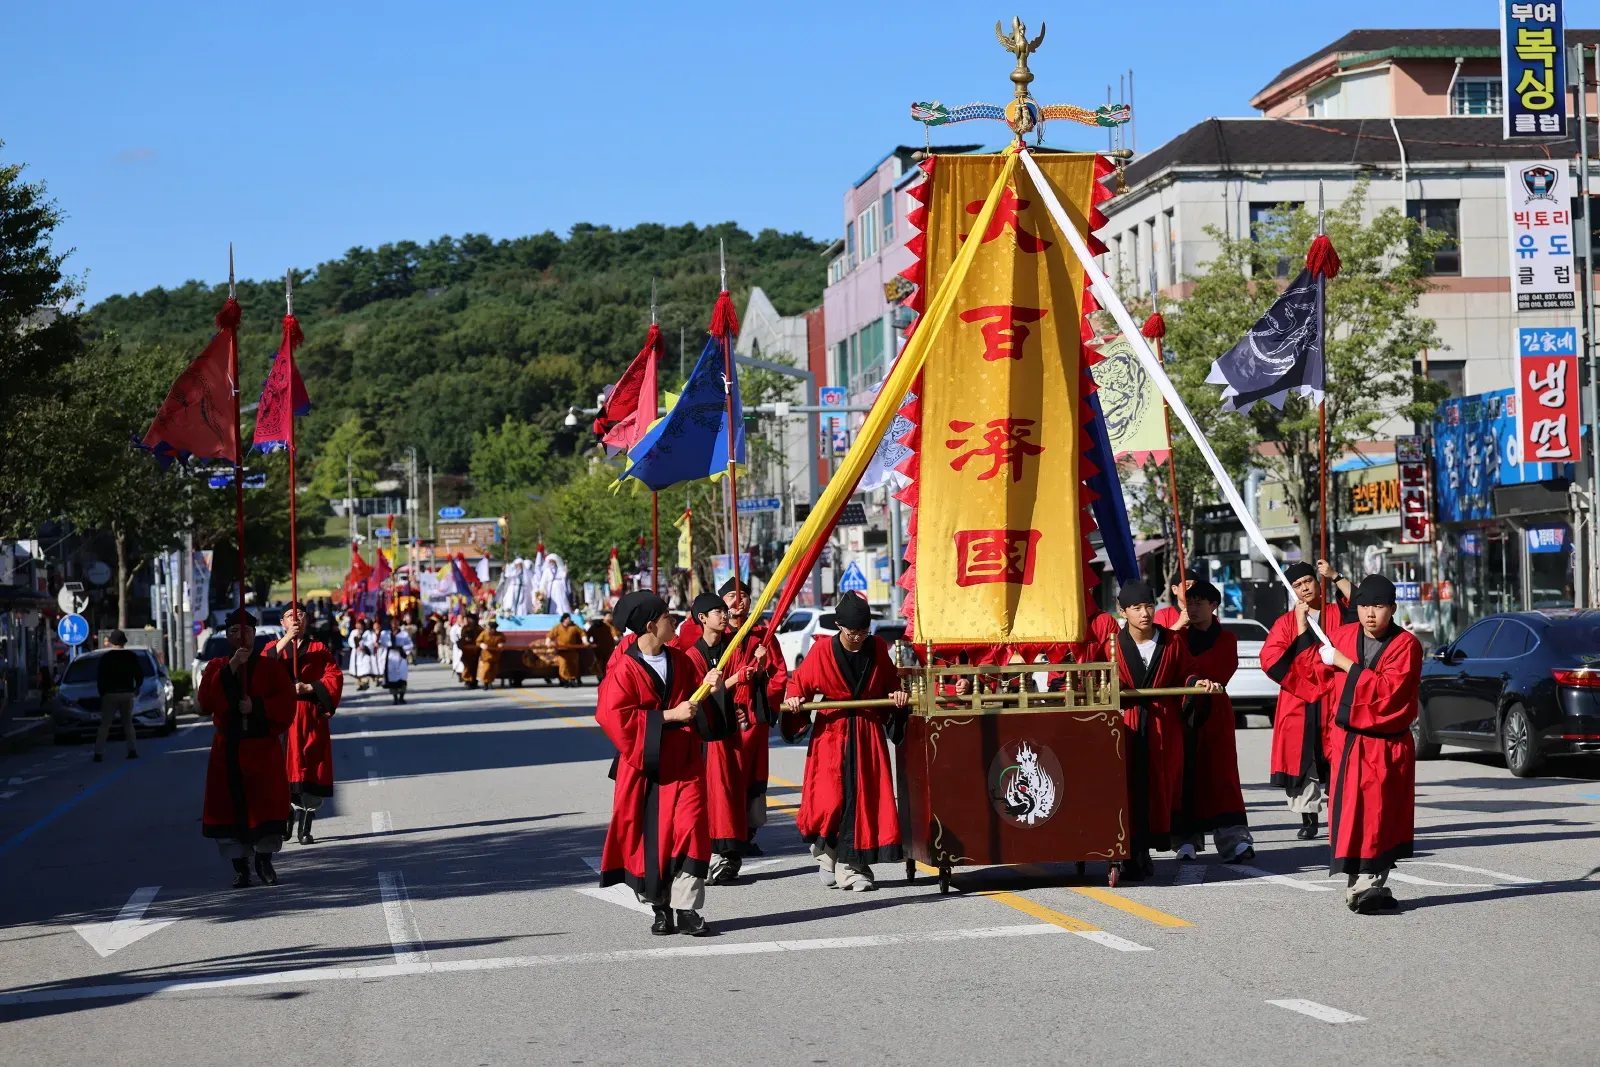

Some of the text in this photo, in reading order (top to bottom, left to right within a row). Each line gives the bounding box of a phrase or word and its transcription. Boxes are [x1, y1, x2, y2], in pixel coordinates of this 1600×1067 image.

[1511, 3, 1557, 23] 부여
[1514, 28, 1557, 111] 복싱
[1515, 114, 1560, 132] 클럽
[1514, 210, 1569, 230] 빅토리
[1516, 235, 1571, 259] 유도
[1518, 265, 1570, 285] 클럽
[1522, 332, 1573, 352] 김家네
[946, 185, 1053, 588] 大百濟國
[1528, 360, 1572, 459] 냉면
[1403, 464, 1429, 540] 보신탕
